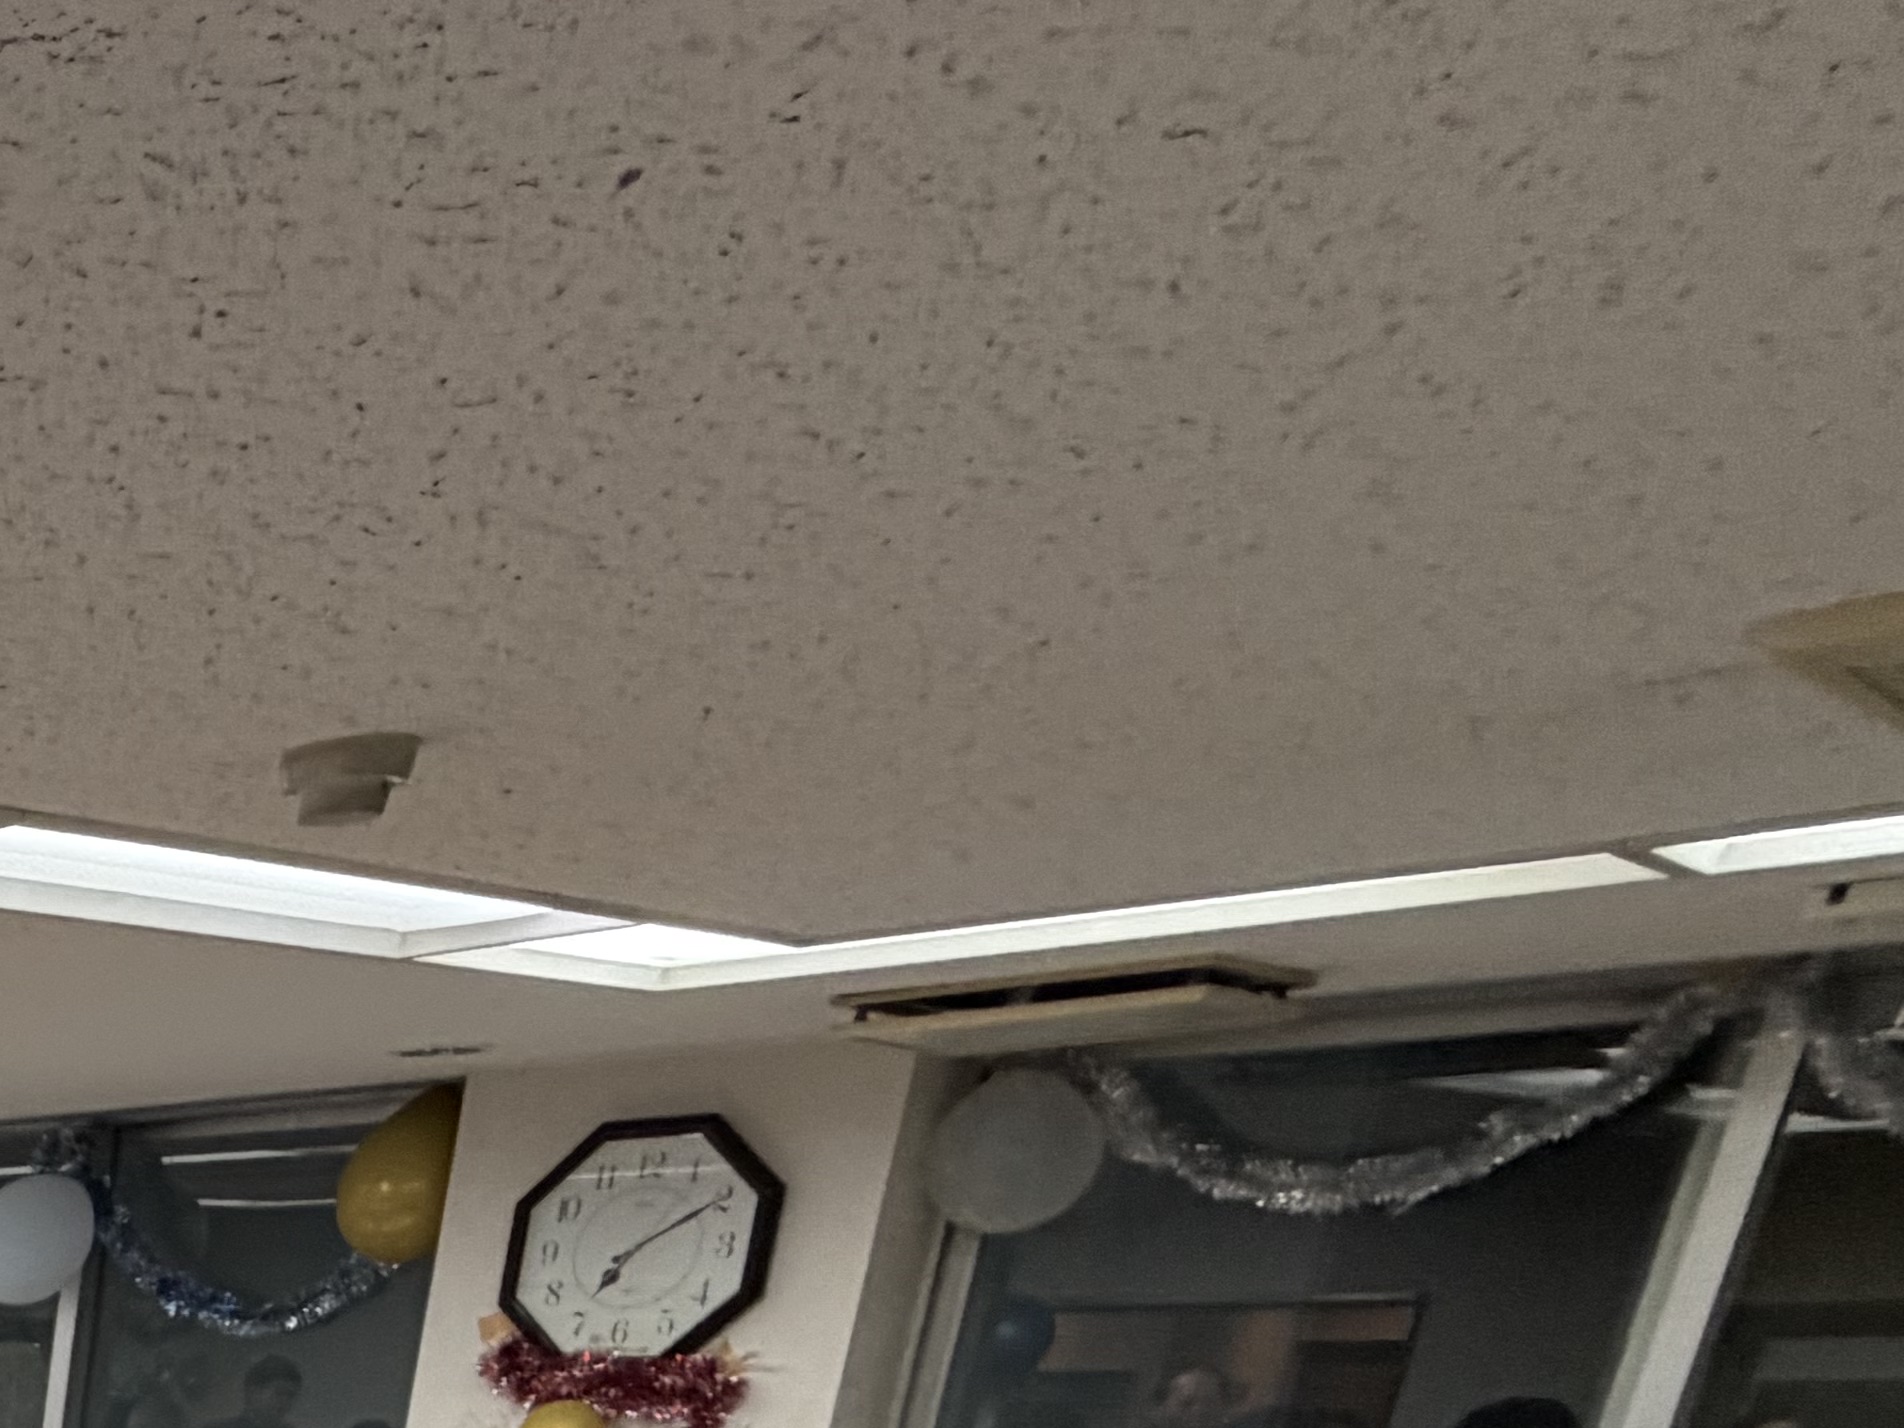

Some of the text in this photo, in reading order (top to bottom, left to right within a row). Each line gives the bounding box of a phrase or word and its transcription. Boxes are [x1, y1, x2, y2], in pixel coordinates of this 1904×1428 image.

[596, 1164, 618, 1190] 11
[639, 1151, 667, 1179] 12
[690, 1157, 702, 1183] 1
[716, 1231, 736, 1258] 3
[544, 1280, 564, 1307] 8
[692, 1278, 710, 1308] 4
[573, 1310, 586, 1336] 7
[611, 1319, 630, 1344] 6
[657, 1308, 675, 1336] 5
